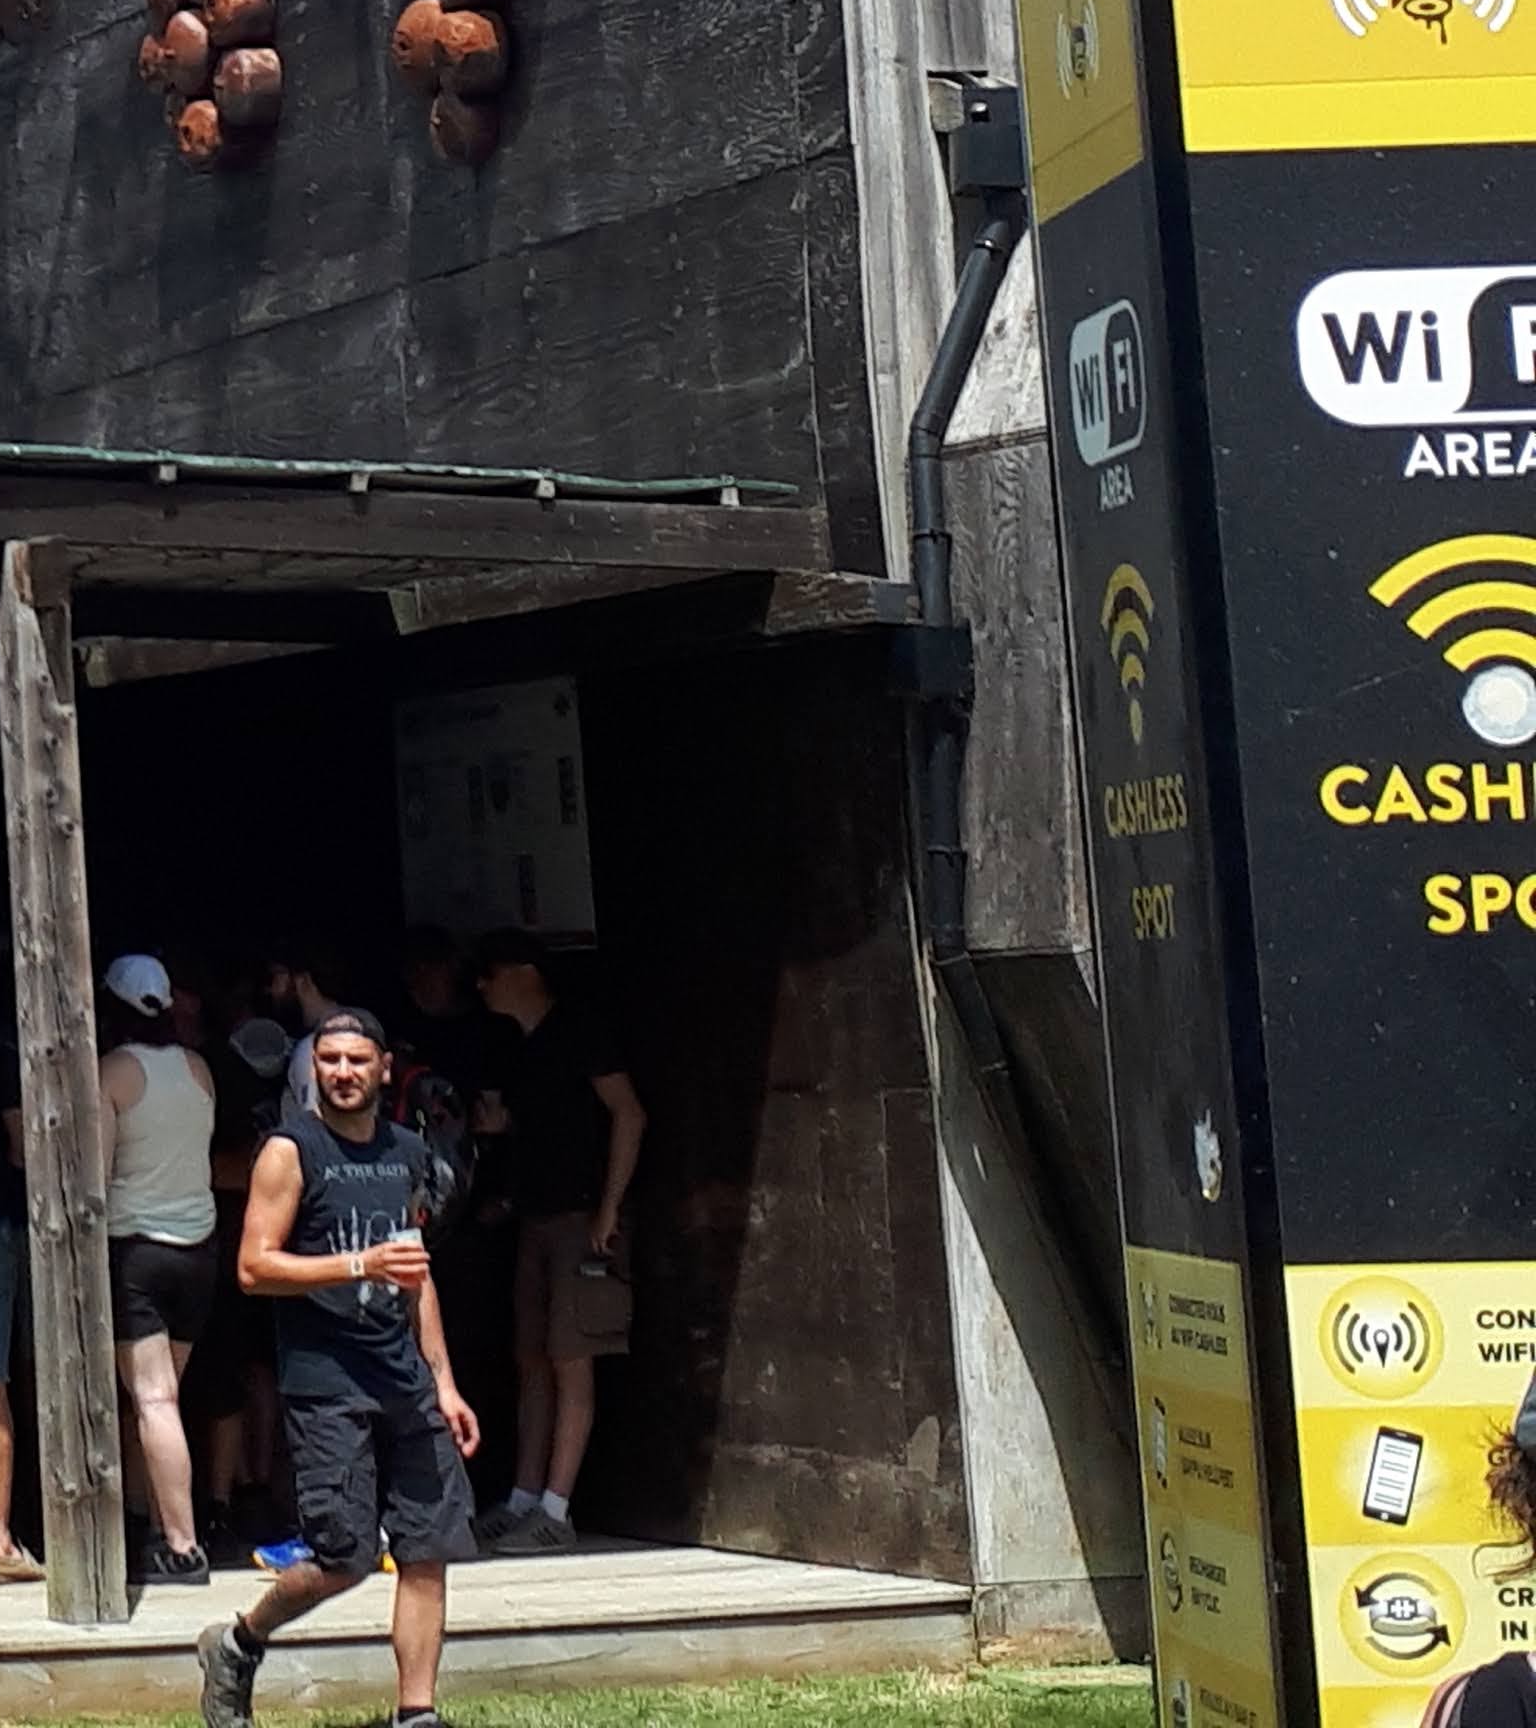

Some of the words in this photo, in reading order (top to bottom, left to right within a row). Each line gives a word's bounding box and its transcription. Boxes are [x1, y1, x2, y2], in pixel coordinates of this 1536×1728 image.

[1099, 463, 1135, 513] AREA
[1103, 772, 1188, 840] CASHLESS
[1320, 761, 1536, 825] CASH
[1132, 883, 1176, 941] SPOT
[1477, 1342, 1536, 1363] WIFI
[1500, 1620, 1529, 1641] IN
